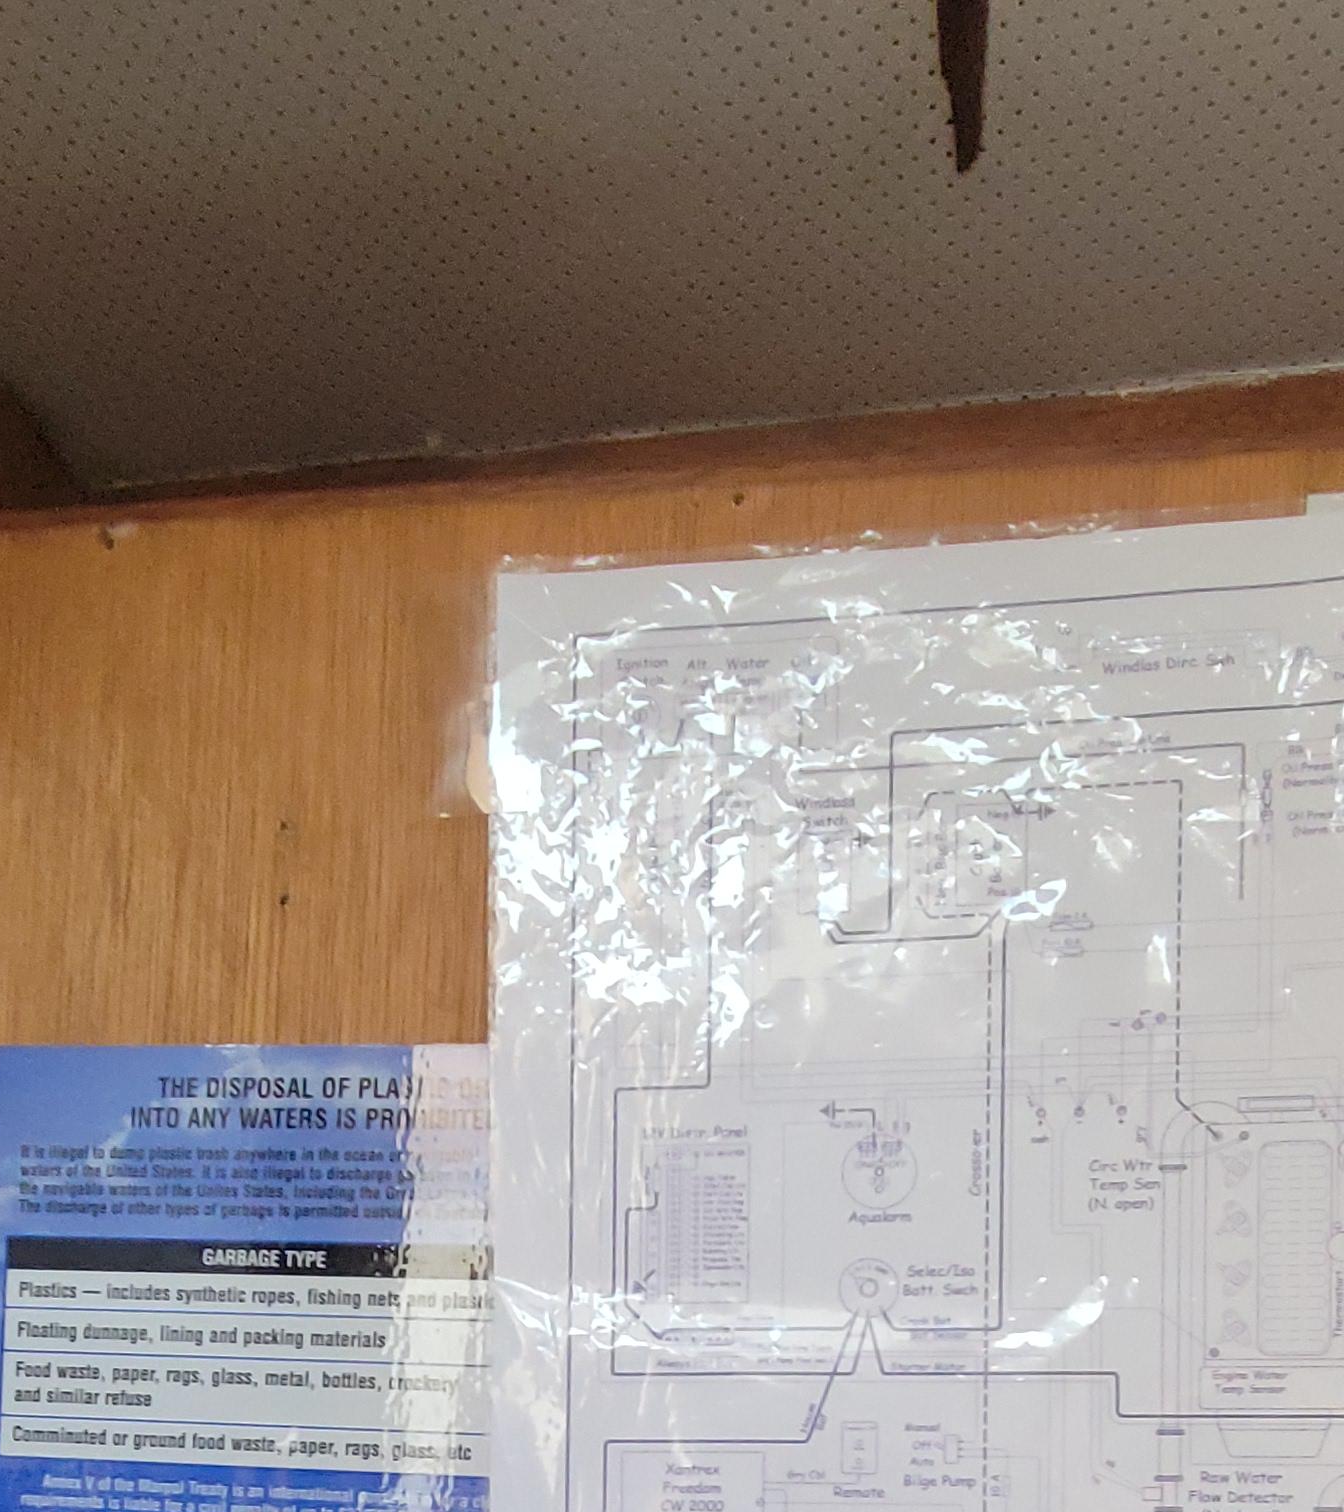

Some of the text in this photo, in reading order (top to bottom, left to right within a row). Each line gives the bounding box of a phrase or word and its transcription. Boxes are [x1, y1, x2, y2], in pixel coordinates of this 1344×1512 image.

[158, 1076, 349, 1100] THE DISPOSAL OF
[131, 1106, 356, 1130] INTO ANY WATERS IS
[968, 1128, 982, 1197] Crossover
[1089, 1178, 1128, 1193] Temp
[202, 1248, 327, 1270] GARBAGE TYPE
[16, 1321, 77, 1343] Floating
[160, 1325, 202, 1346] lining
[210, 1326, 238, 1344] and
[244, 1327, 304, 1349] packing
[310, 1329, 387, 1350] materials
[14, 1387, 152, 1408] and similar refuse
[1235, 1471, 1283, 1484] Water
[1227, 1491, 1294, 1503] Detector
